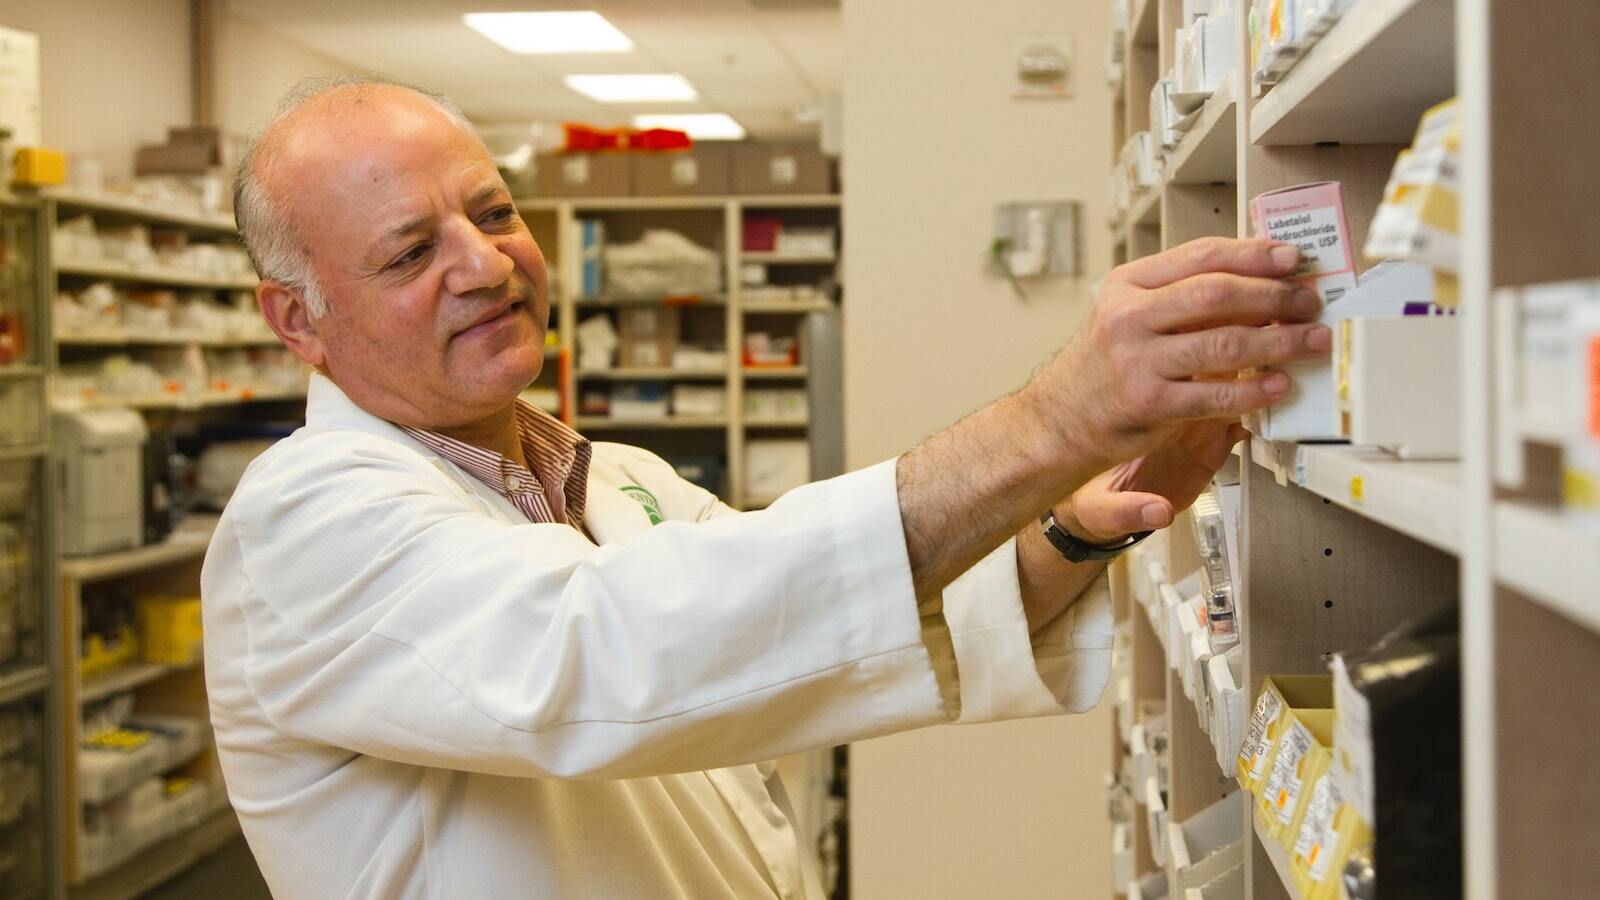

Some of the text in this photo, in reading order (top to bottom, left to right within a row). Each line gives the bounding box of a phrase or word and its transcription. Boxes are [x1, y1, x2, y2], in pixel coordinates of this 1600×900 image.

[1268, 214, 1311, 230] Labetalol
[1271, 223, 1336, 240] Hydrochloride
[1319, 235, 1338, 247] USP
